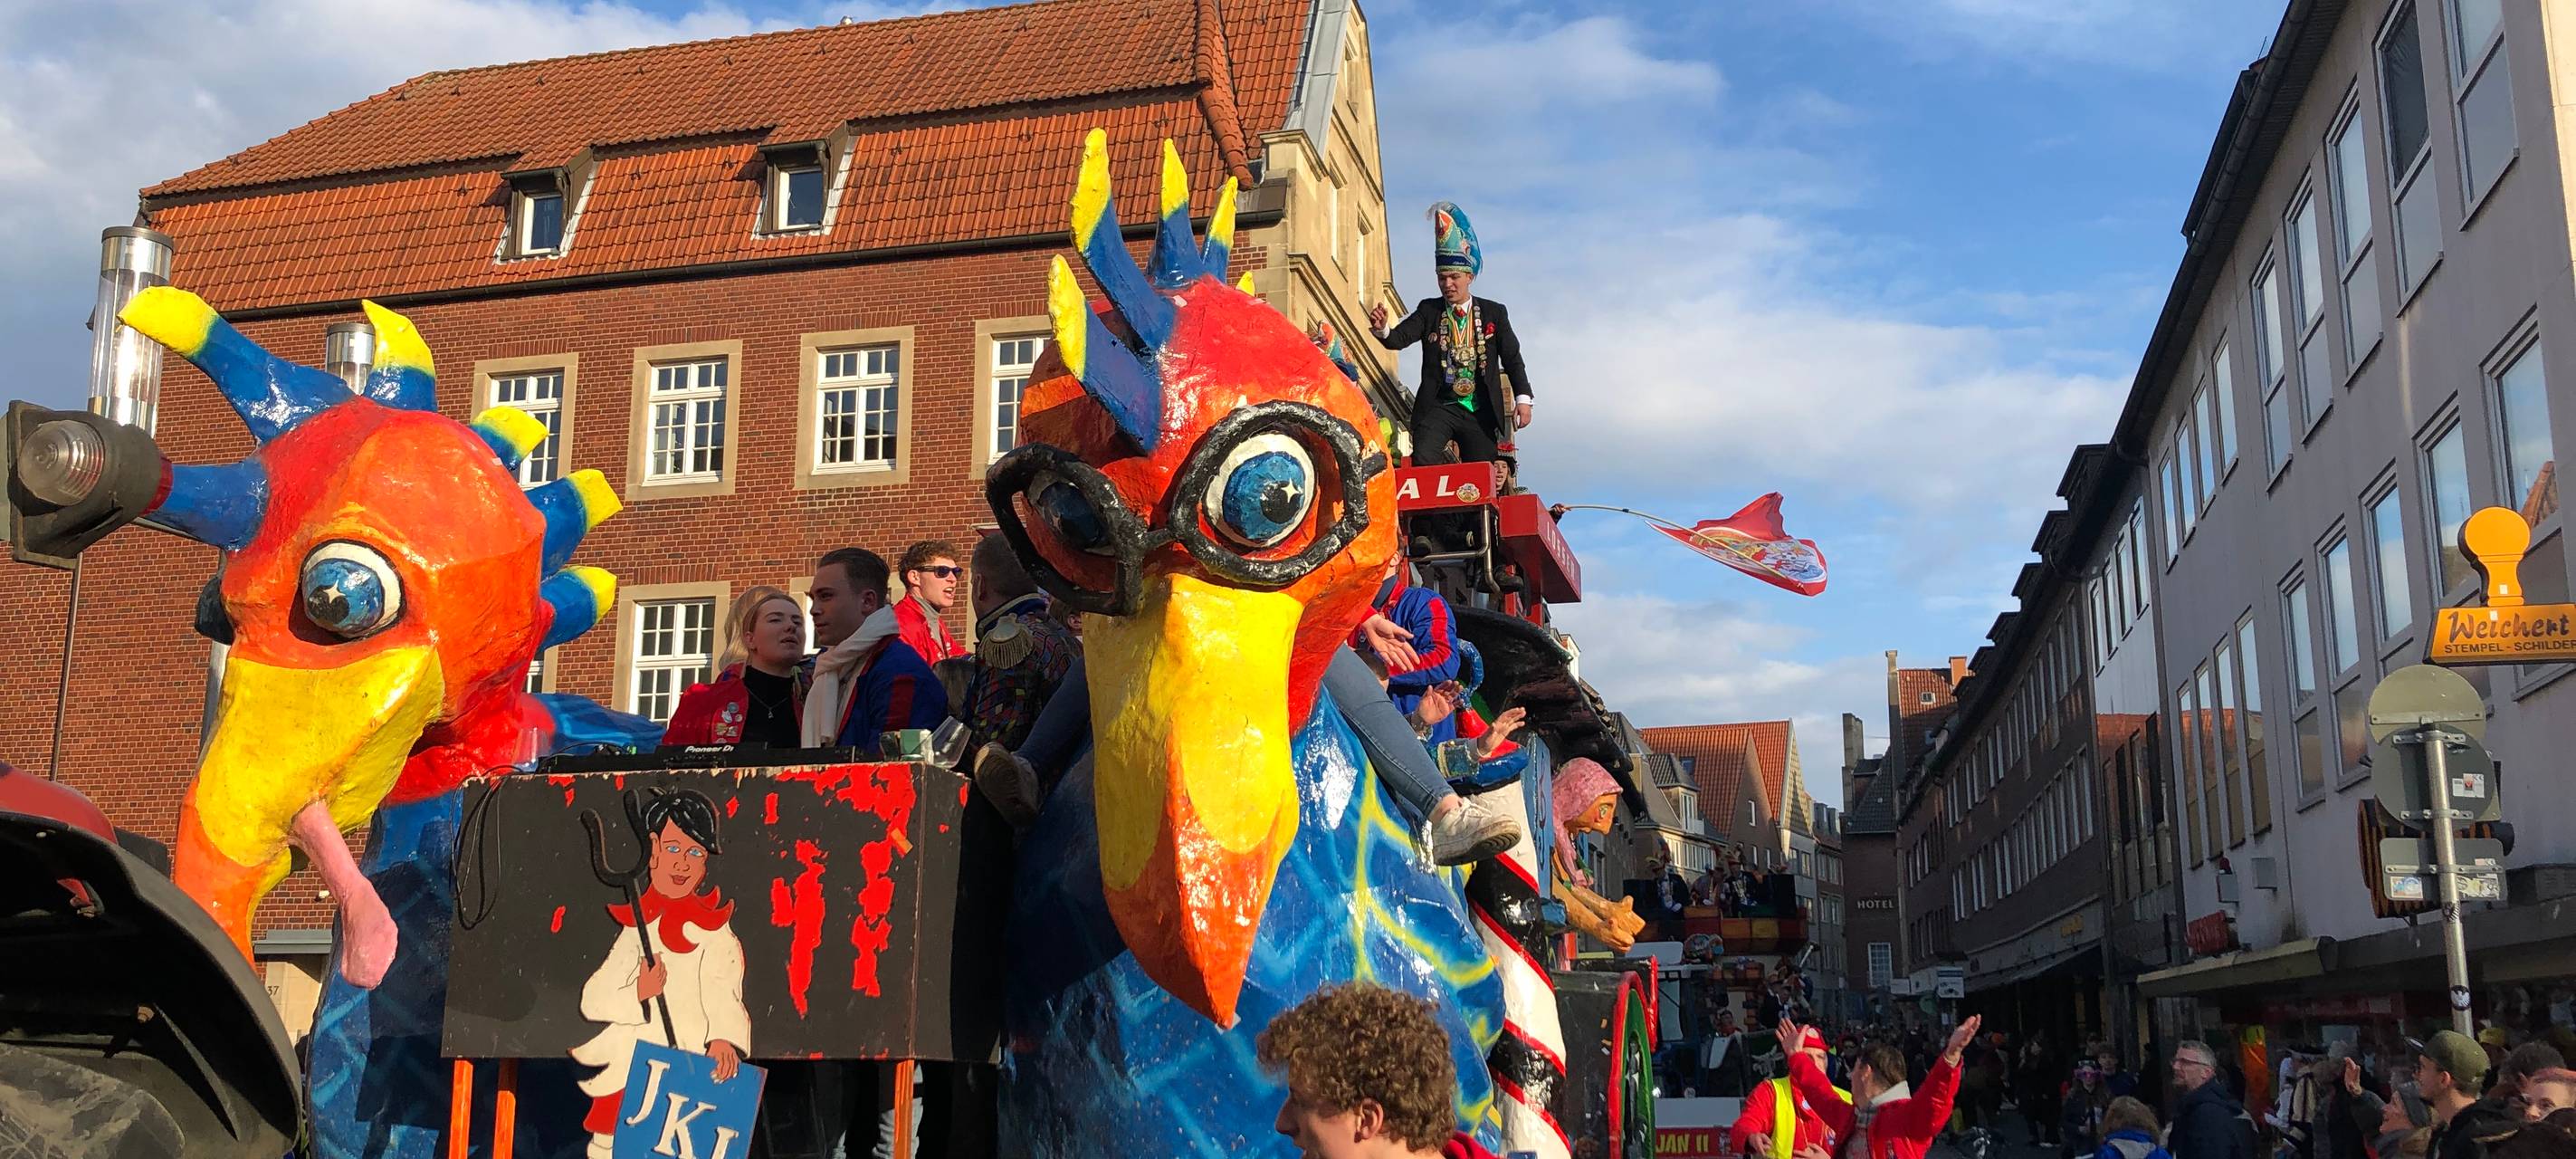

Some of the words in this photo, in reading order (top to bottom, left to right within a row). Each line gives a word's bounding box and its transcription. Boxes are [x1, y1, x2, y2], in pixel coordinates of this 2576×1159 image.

[2447, 610, 2570, 644] Weichert
[2444, 642, 2504, 654] STEMPEL
[684, 745, 722, 753] Pioneer
[1856, 899, 1894, 909] HOTEL
[267, 985, 280, 996] 37
[1655, 1133, 1691, 1154] JAN
